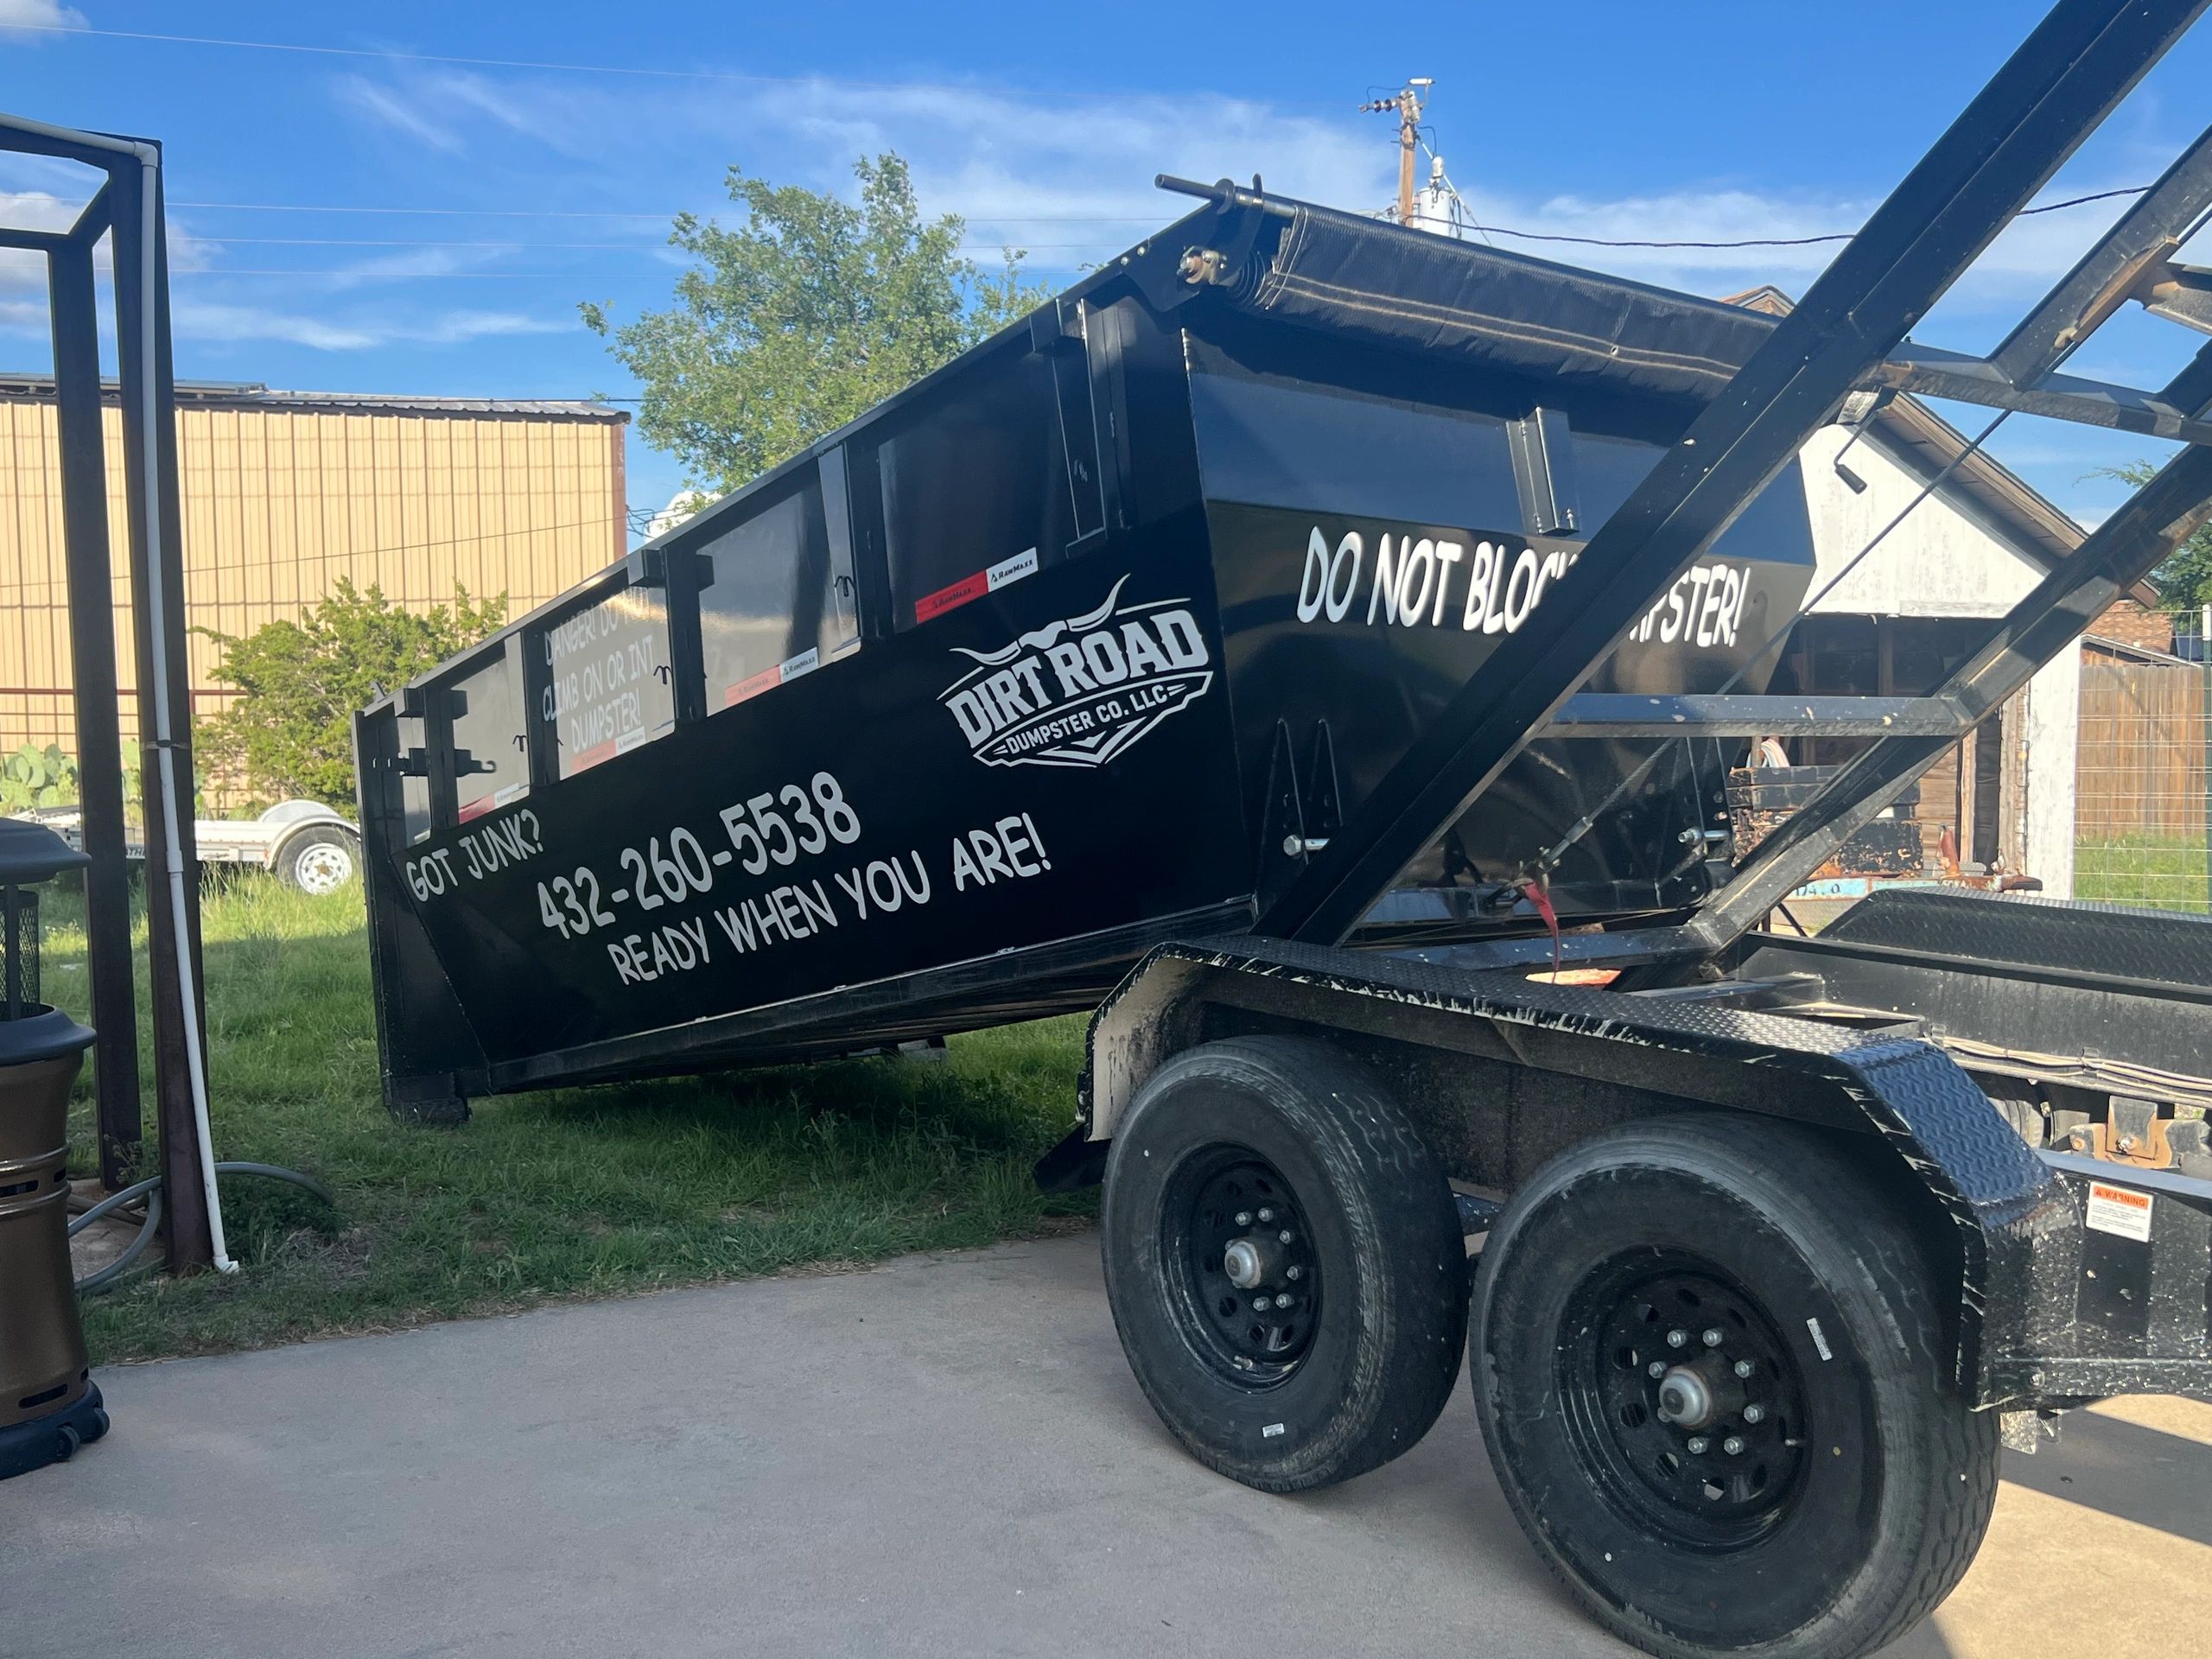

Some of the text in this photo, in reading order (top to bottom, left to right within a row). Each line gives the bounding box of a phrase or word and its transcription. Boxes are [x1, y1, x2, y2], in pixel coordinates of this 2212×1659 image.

[1297, 525, 1363, 623] DO
[1367, 532, 1463, 628] NOT
[1463, 541, 1579, 634] BLOC
[544, 604, 596, 665] DANGER!
[543, 672, 580, 721] CLIMB
[583, 661, 603, 702] ON
[607, 650, 626, 690] OR
[944, 609, 1209, 749] DIRT ROAD
[1005, 684, 1167, 753] DUMPSTER CO. LLC
[571, 688, 641, 753] DUMPSTER!
[406, 808, 543, 902] GOT JUNK?
[537, 772, 861, 939] 432-260-5538
[607, 812, 1052, 985] READY WHEN YOU ARE!
[2105, 1191, 2145, 1207] WARNING
